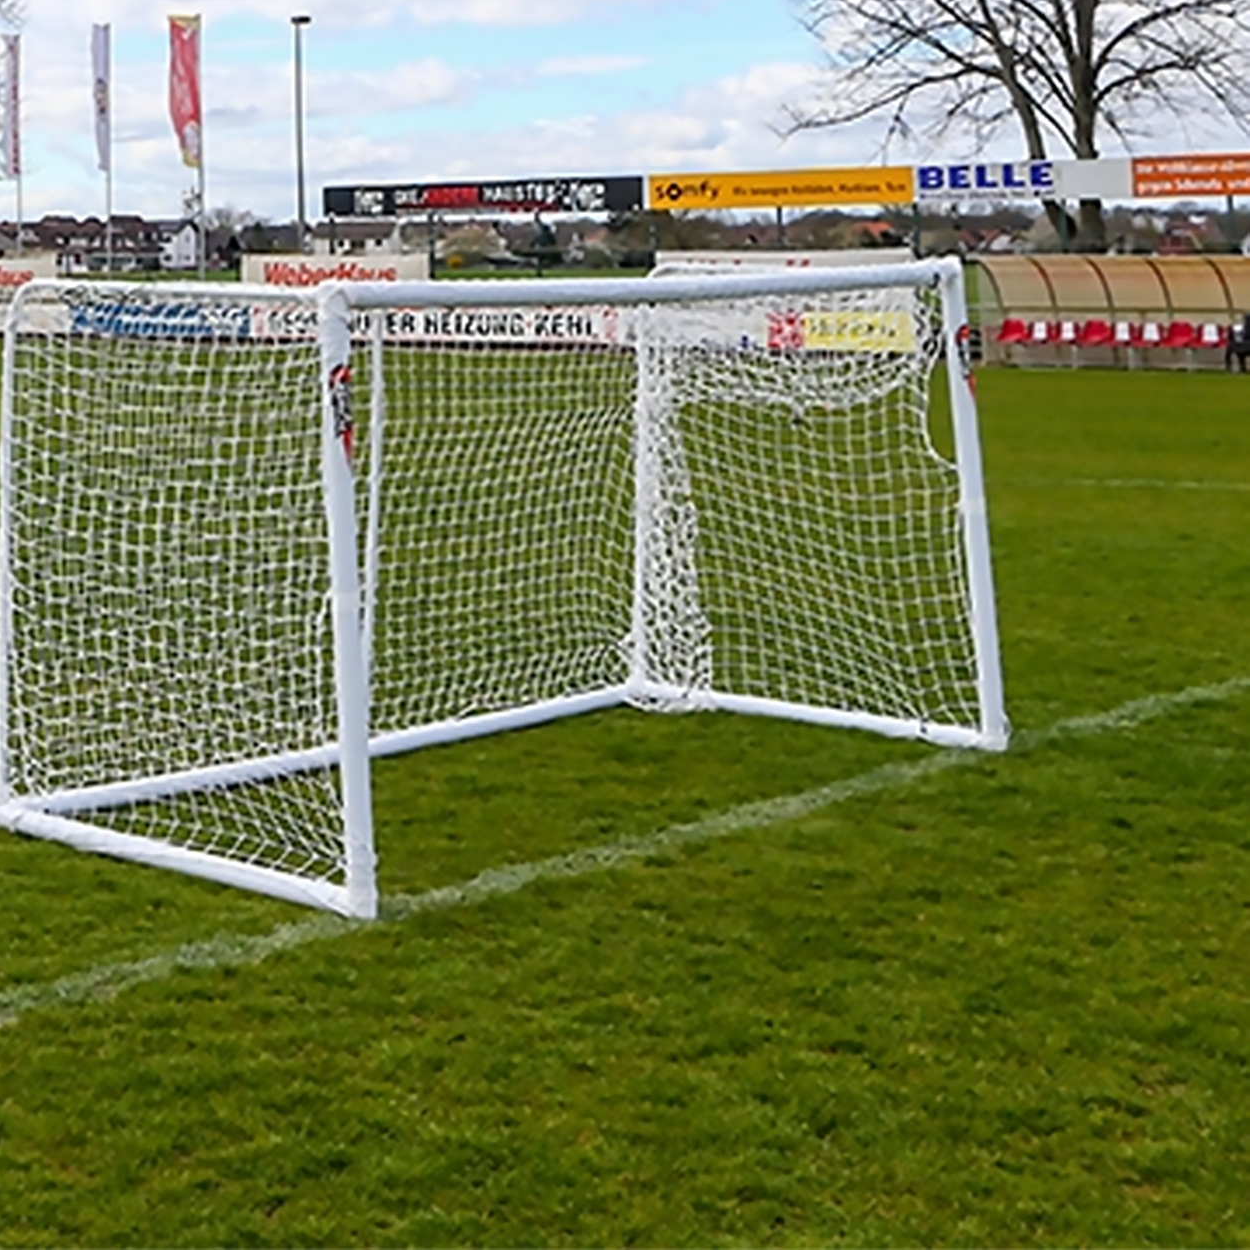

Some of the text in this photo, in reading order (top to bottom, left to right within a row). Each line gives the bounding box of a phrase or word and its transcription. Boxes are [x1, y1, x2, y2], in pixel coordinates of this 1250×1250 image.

[918, 162, 1054, 189] BELLE
[655, 179, 720, 200] somfy
[423, 312, 526, 337] HEIZUNG
